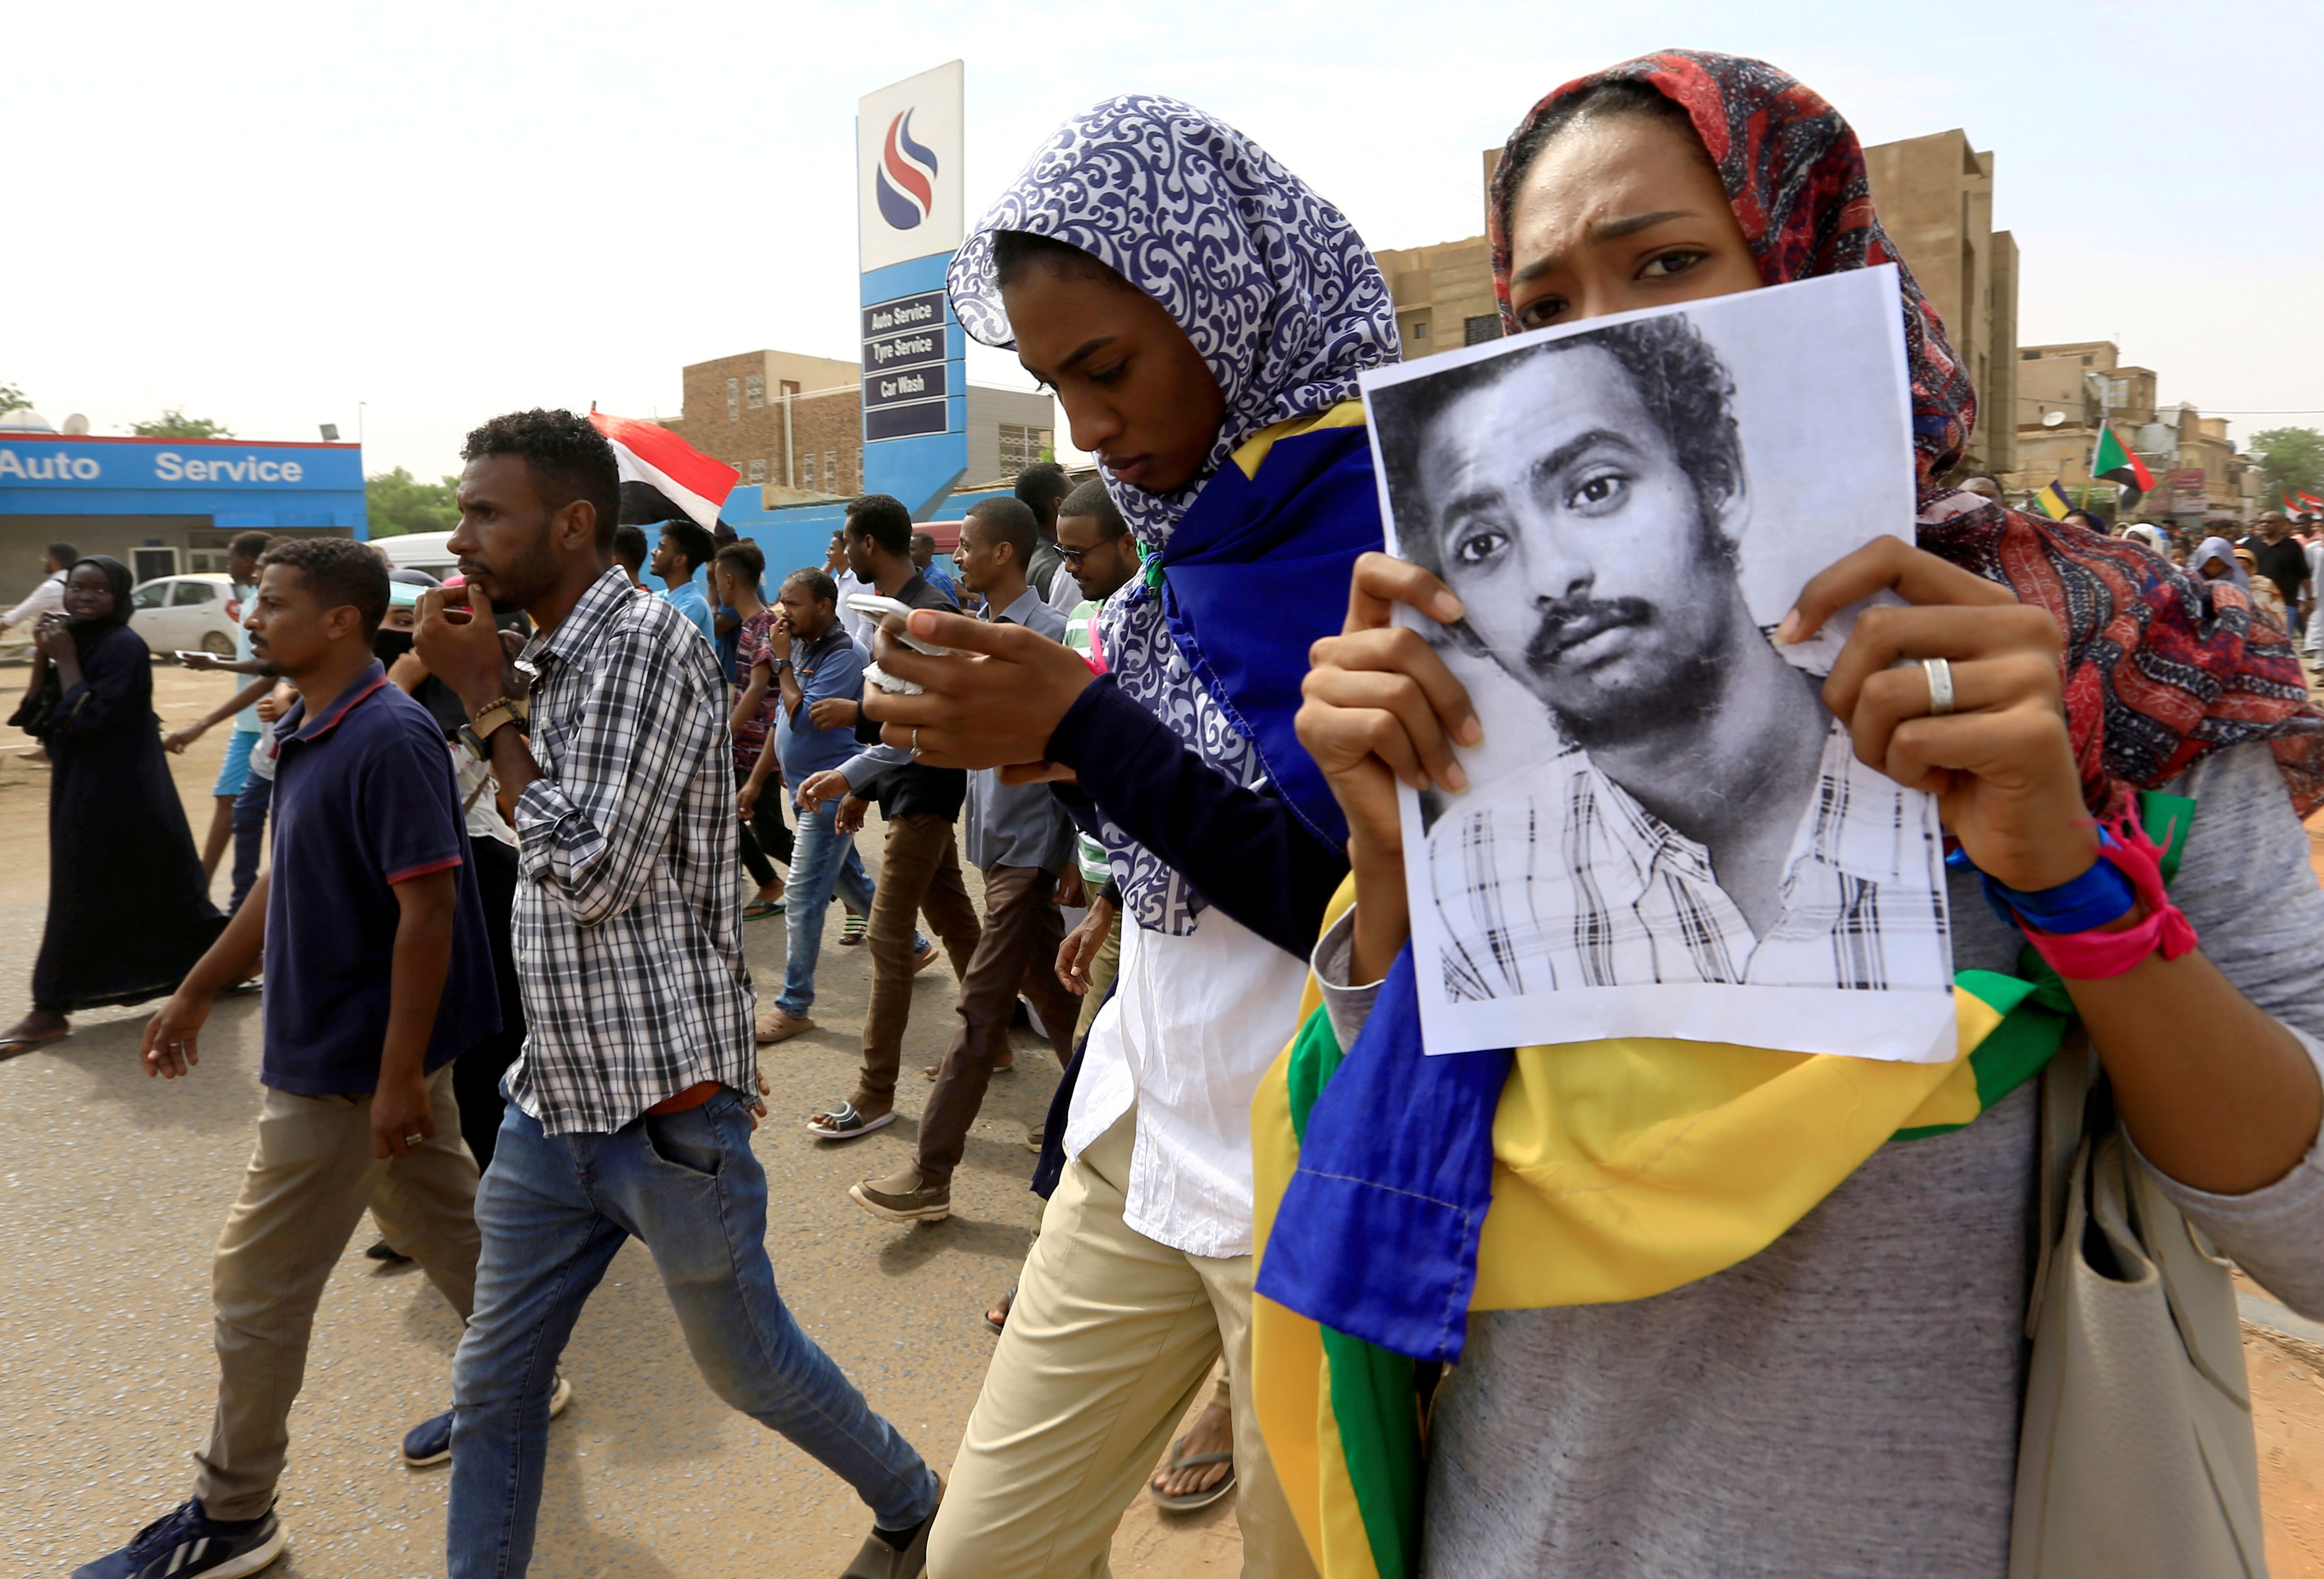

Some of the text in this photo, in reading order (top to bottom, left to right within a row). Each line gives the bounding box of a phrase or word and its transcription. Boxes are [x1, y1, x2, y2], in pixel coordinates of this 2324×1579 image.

[872, 303, 932, 330] Auto Service
[873, 336, 932, 364] Tyre Service
[881, 374, 925, 398] Car Wash
[0, 449, 304, 482] Auto Service
